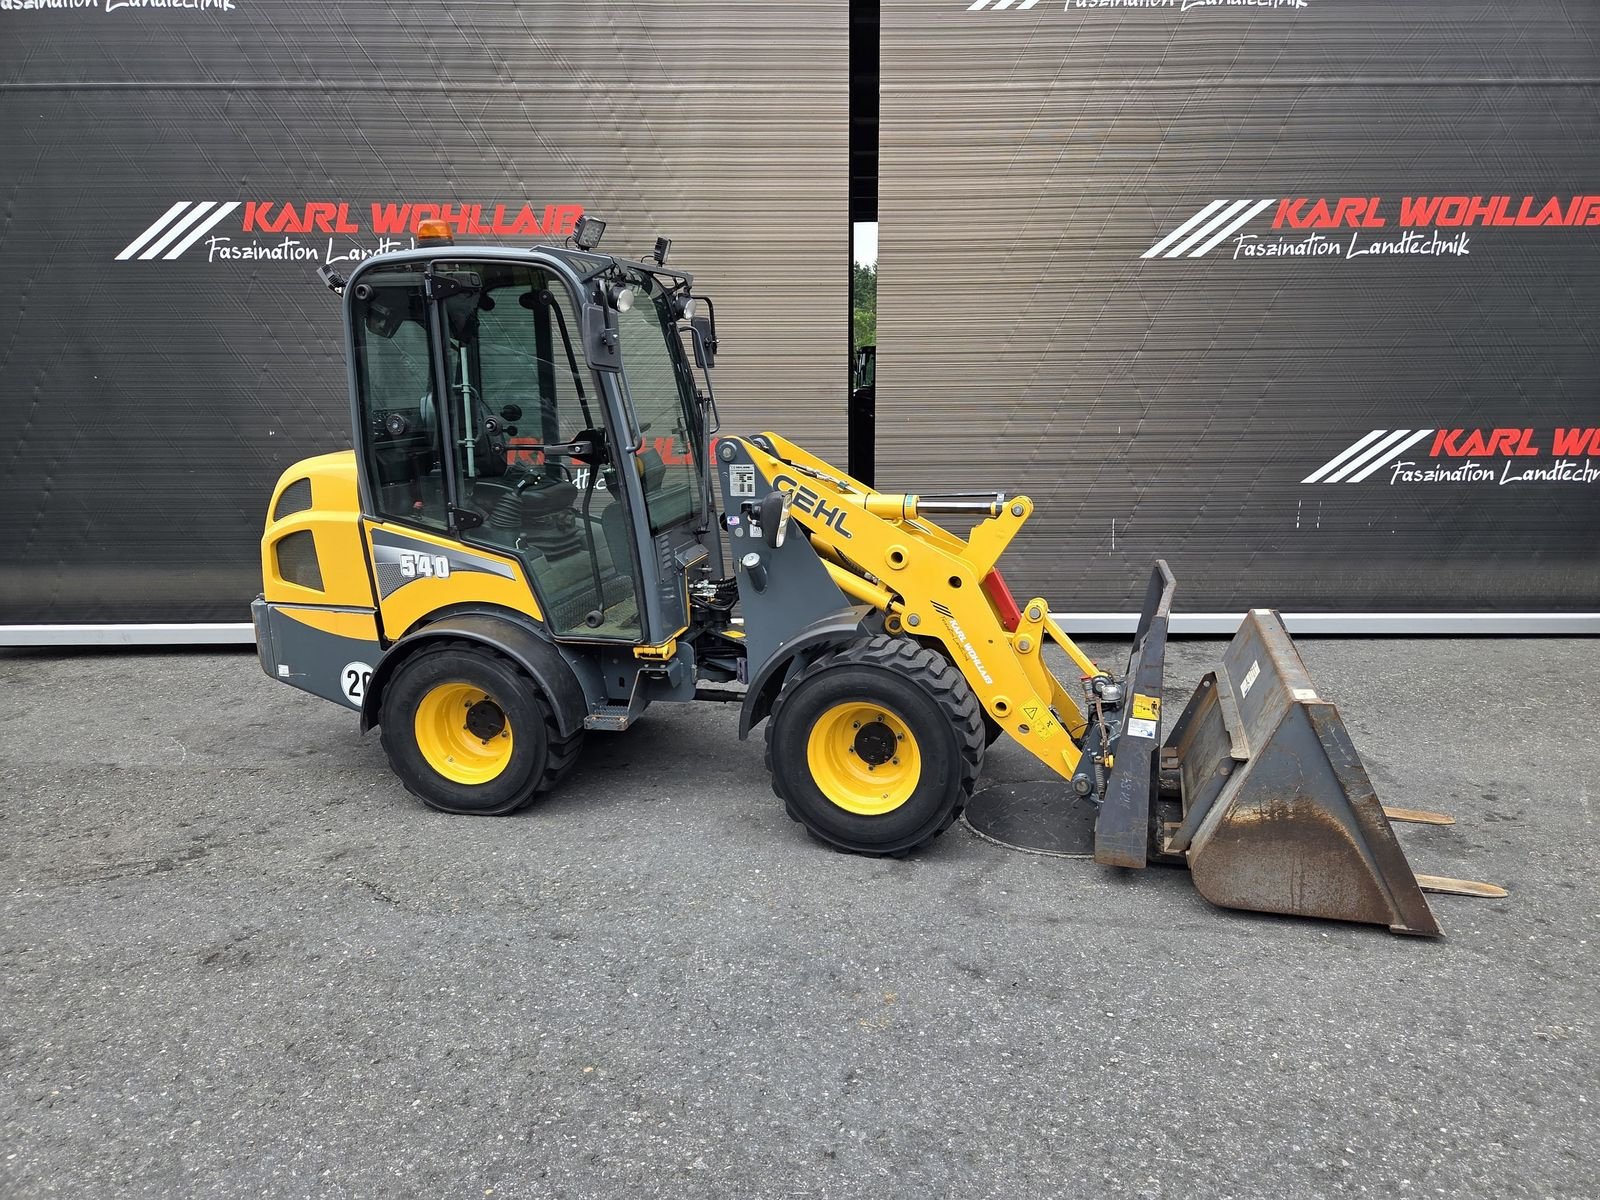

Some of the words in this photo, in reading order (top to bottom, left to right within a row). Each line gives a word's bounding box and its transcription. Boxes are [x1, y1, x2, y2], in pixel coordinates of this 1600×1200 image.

[243, 201, 359, 233] KARL
[1272, 197, 1385, 229] KARL
[1400, 196, 1600, 227] WOHLLAIB
[205, 235, 319, 262] Faszination
[1233, 231, 1341, 260] Faszination
[1346, 230, 1470, 260] Landtechnik
[1429, 428, 1539, 457] KARL
[1390, 459, 1495, 486] Faszination
[772, 474, 853, 540] GEHL
[400, 553, 450, 579] 540
[949, 618, 967, 643] KARL
